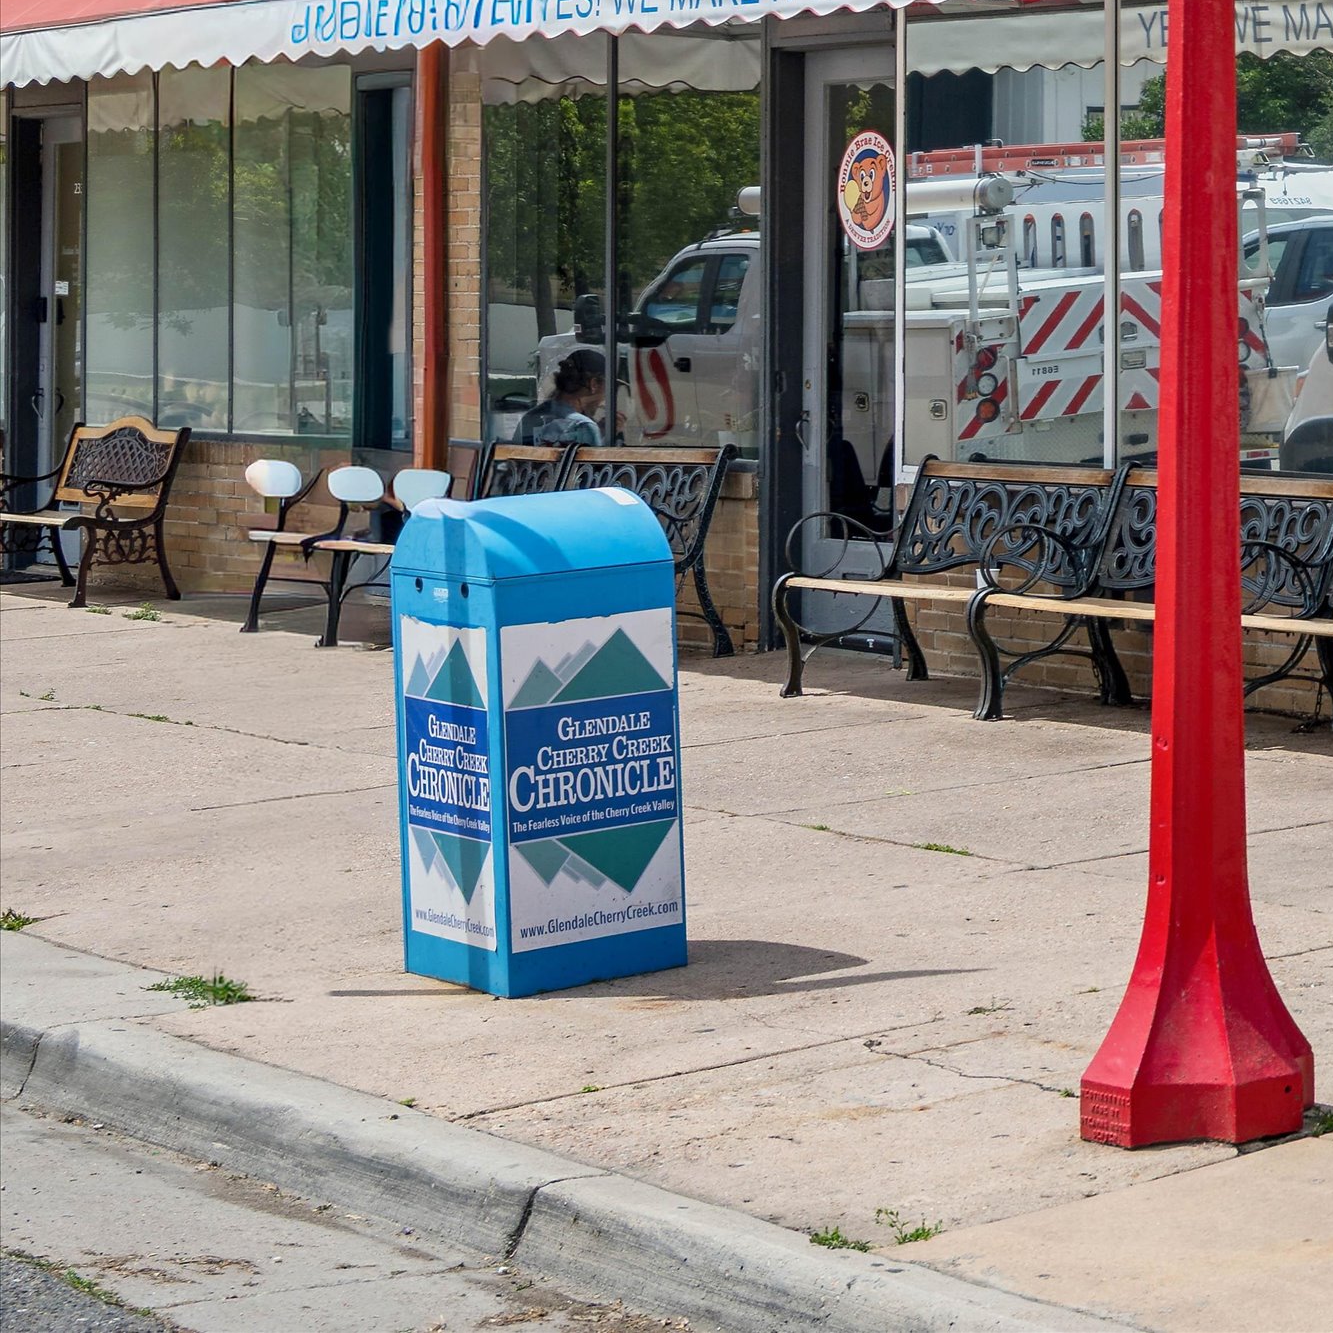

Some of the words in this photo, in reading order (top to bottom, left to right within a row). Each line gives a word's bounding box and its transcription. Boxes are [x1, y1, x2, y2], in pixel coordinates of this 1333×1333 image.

[839, 149, 855, 193] Bonnie
[854, 136, 872, 151] Brae
[873, 136, 885, 153] Ice
[884, 149, 896, 192] Cream
[428, 714, 476, 745] GLENDALE
[557, 711, 651, 741] GLENDALE
[419, 738, 455, 769] CHERRY
[456, 745, 488, 774] CREEK
[537, 745, 610, 771] CHERRY
[612, 734, 673, 760] CREEK
[408, 752, 490, 812] CHRONICLE
[509, 755, 675, 813] CHRONICLE
[512, 822, 528, 833] The
[528, 816, 560, 831] Fearless
[560, 814, 581, 826] Voice
[582, 812, 591, 822] of
[590, 810, 605, 821] the
[605, 806, 630, 819] Cherry
[630, 803, 652, 814] Creek
[652, 799, 675, 811] Valley
[520, 900, 679, 939] www.GlendaleCherryCreek.com
